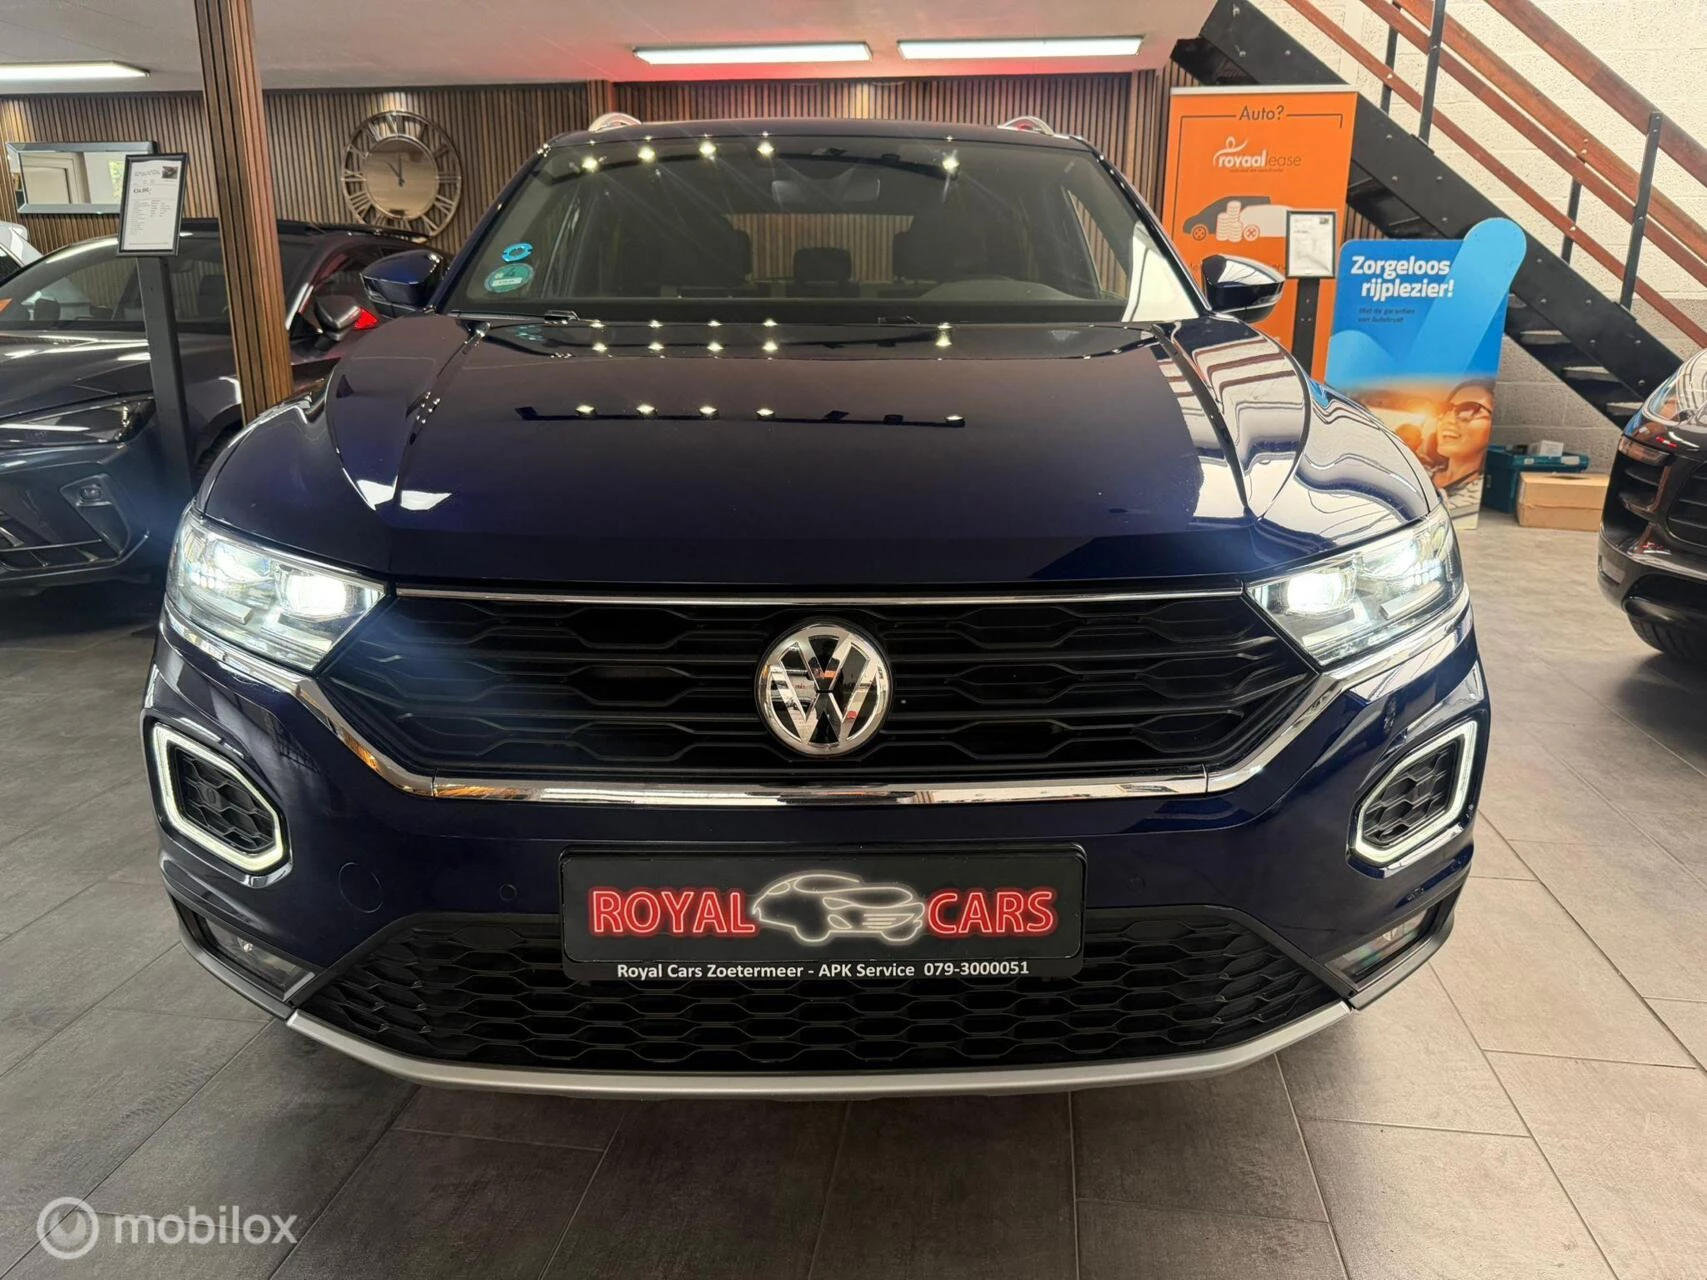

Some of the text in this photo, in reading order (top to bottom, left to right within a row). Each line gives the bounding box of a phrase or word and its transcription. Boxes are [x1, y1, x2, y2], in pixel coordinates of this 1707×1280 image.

[1239, 105, 1285, 121] Auto?
[1350, 256, 1450, 278] Zorgeloos
[1361, 280, 1454, 302] rijplezier!
[588, 887, 1058, 936] ROYAL CARS
[617, 964, 663, 979] Royal
[667, 964, 704, 979] Cars
[707, 964, 804, 978] Zoetermeer
[818, 963, 852, 977] APK
[856, 963, 915, 977] Service
[924, 962, 1029, 977] 079-3000051
